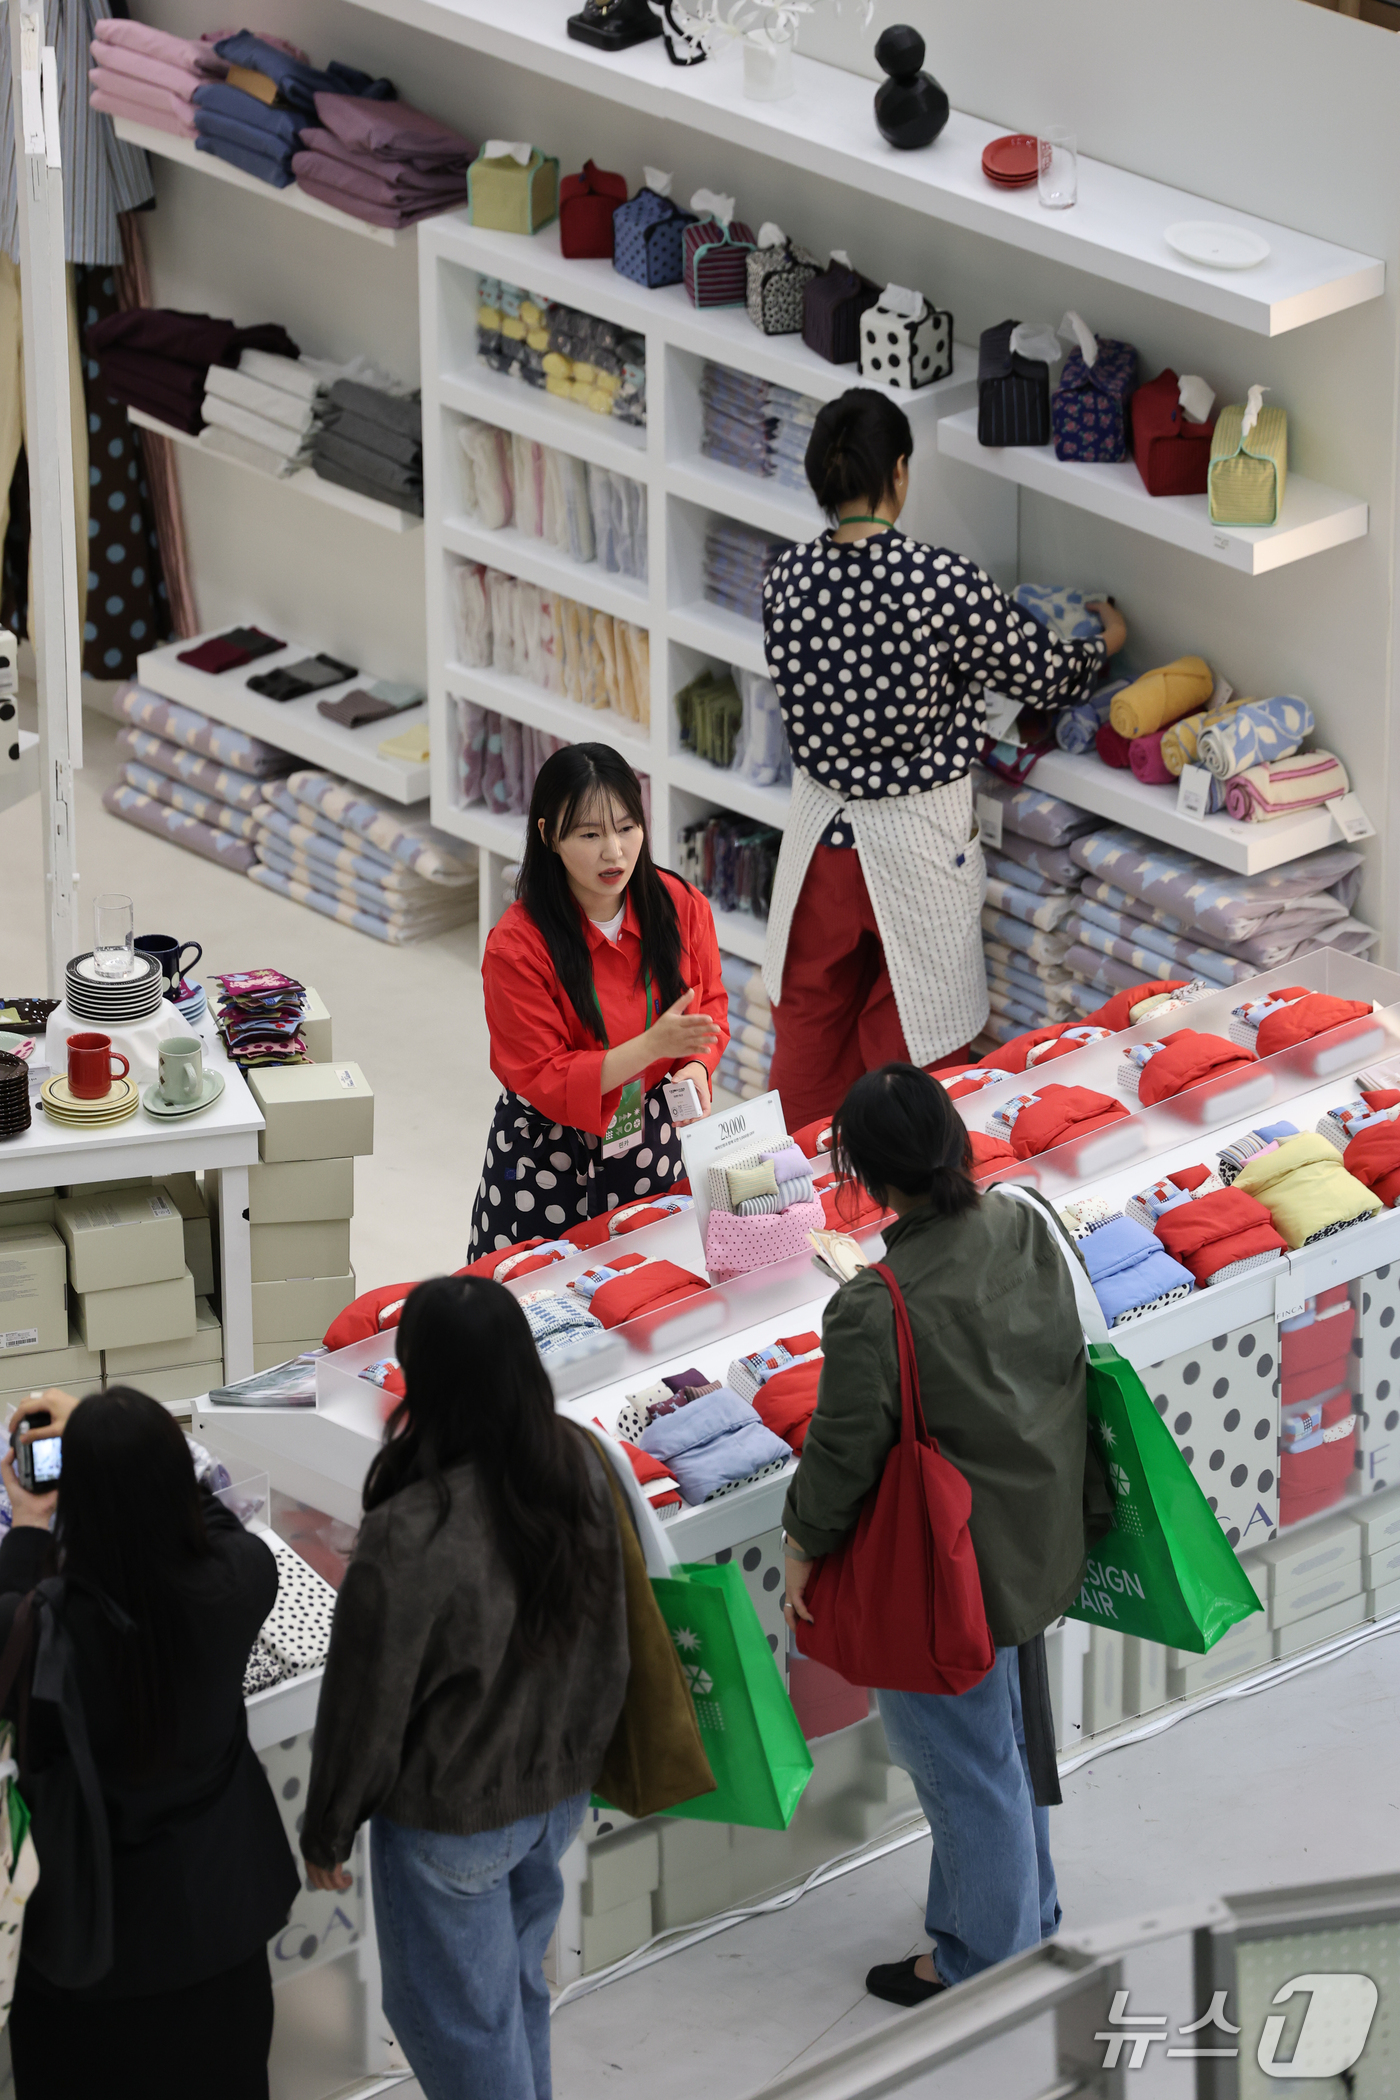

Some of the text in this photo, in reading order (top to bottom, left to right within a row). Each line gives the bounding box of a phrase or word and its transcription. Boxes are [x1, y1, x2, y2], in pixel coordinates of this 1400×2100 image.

[717, 1114, 747, 1141] 29,000
[1276, 1305, 1303, 1320] FINCA
[1085, 1558, 1146, 1600] SIGN
[1074, 1585, 1119, 1619] AIR
